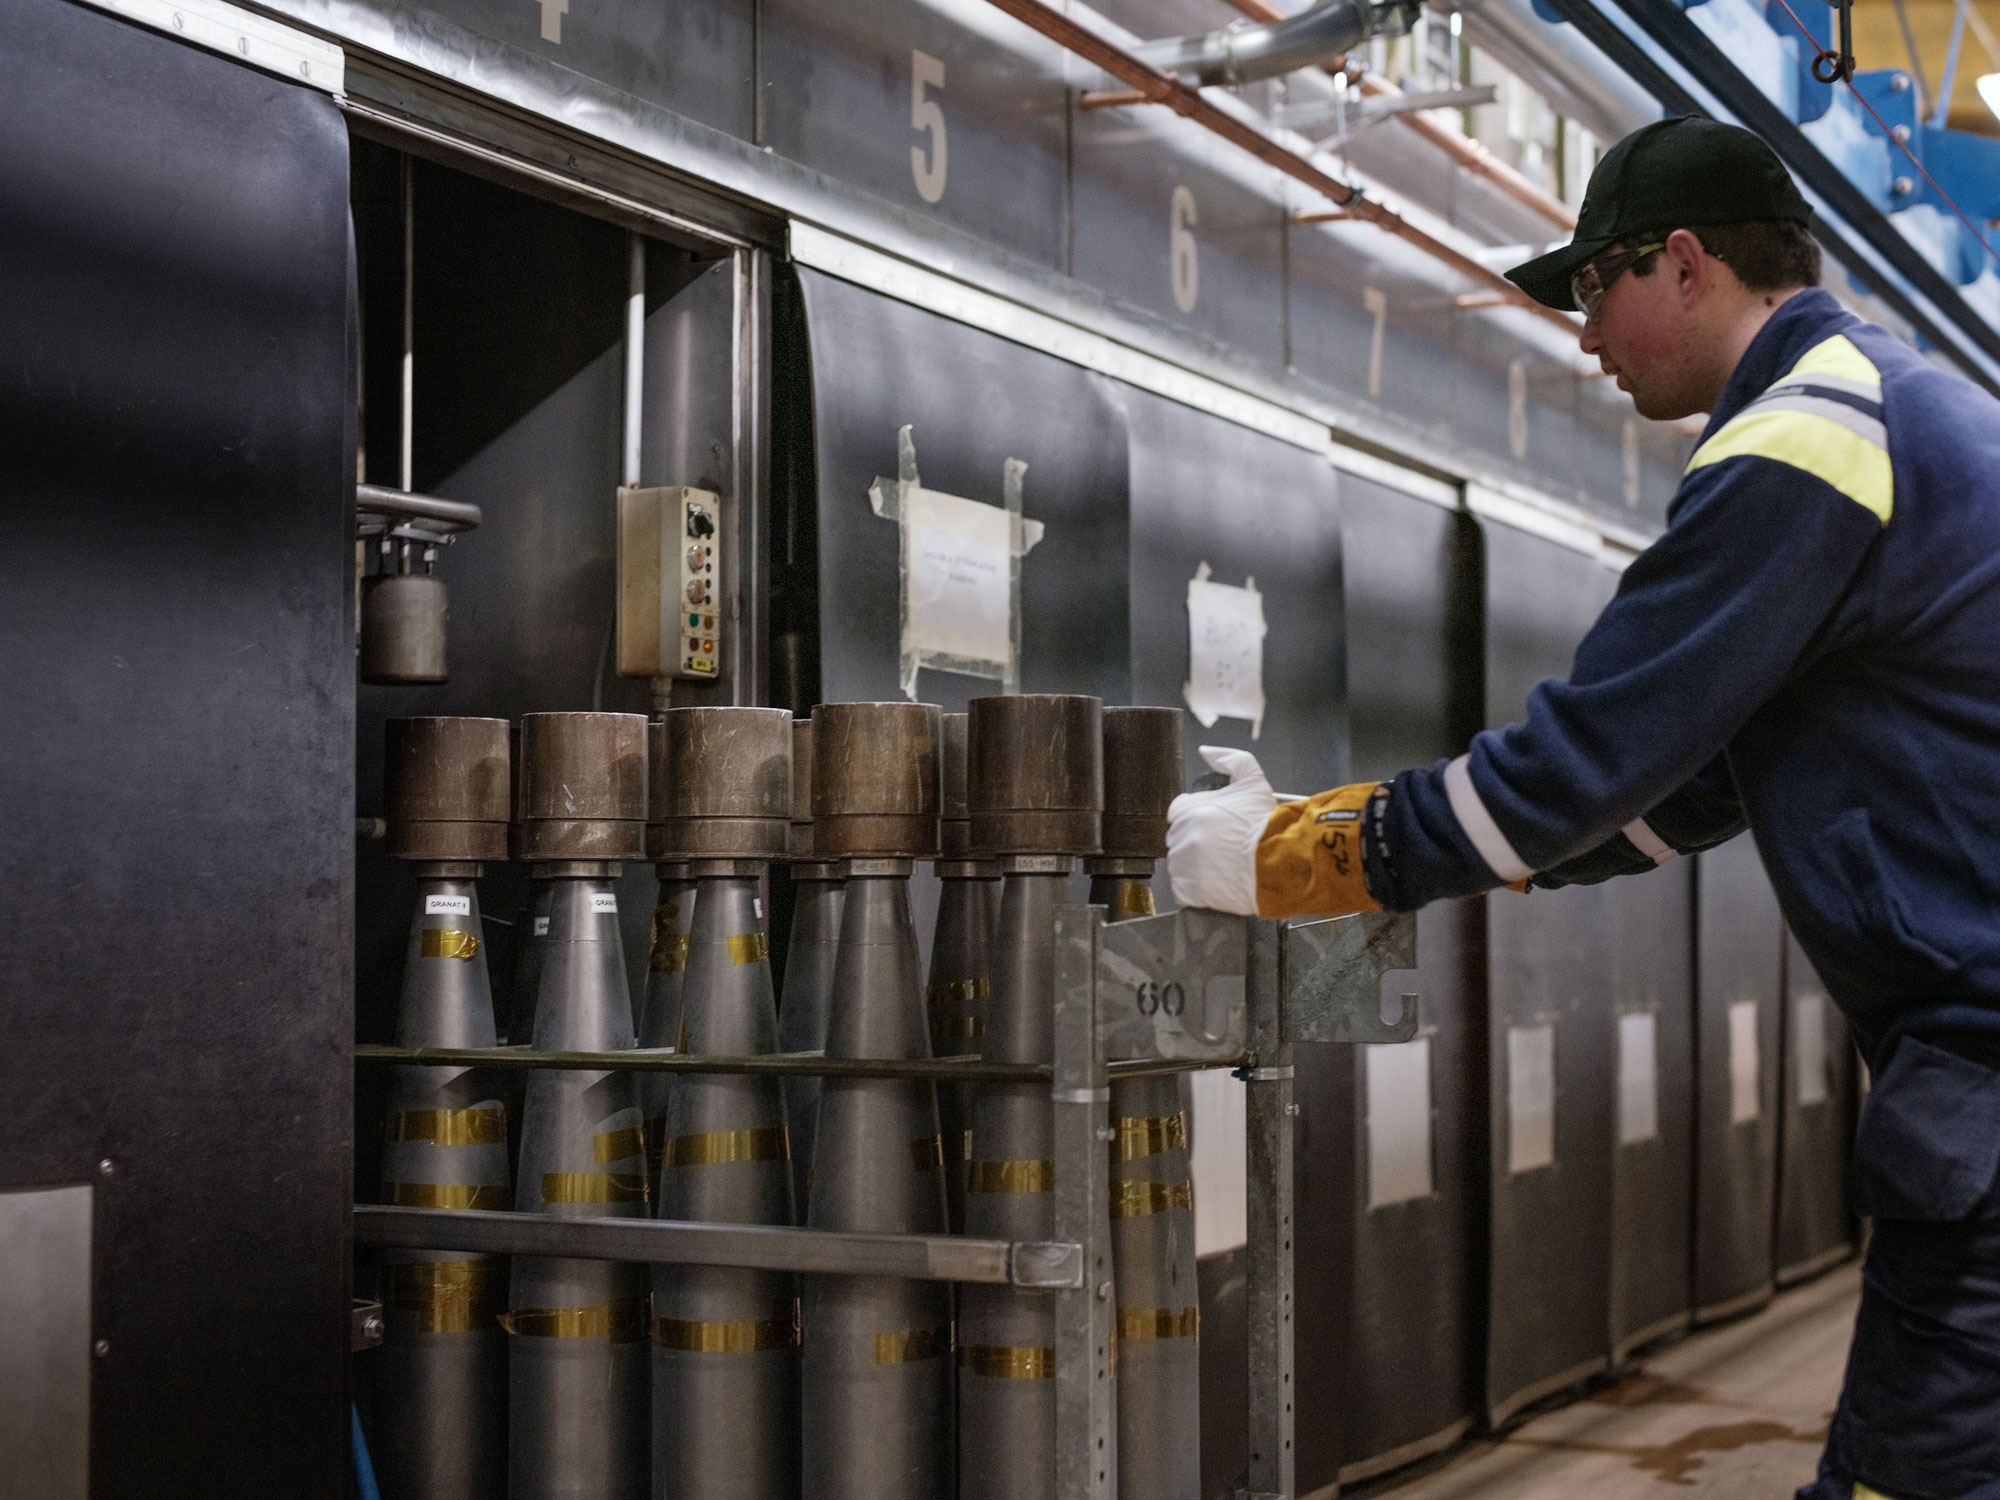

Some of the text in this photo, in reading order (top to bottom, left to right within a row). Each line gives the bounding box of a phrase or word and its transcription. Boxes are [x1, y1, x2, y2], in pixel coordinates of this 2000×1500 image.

[911, 49, 947, 204] 5
[1169, 184, 1198, 313] 6
[1362, 286, 1386, 397] 7
[1137, 981, 1185, 1017] 60
